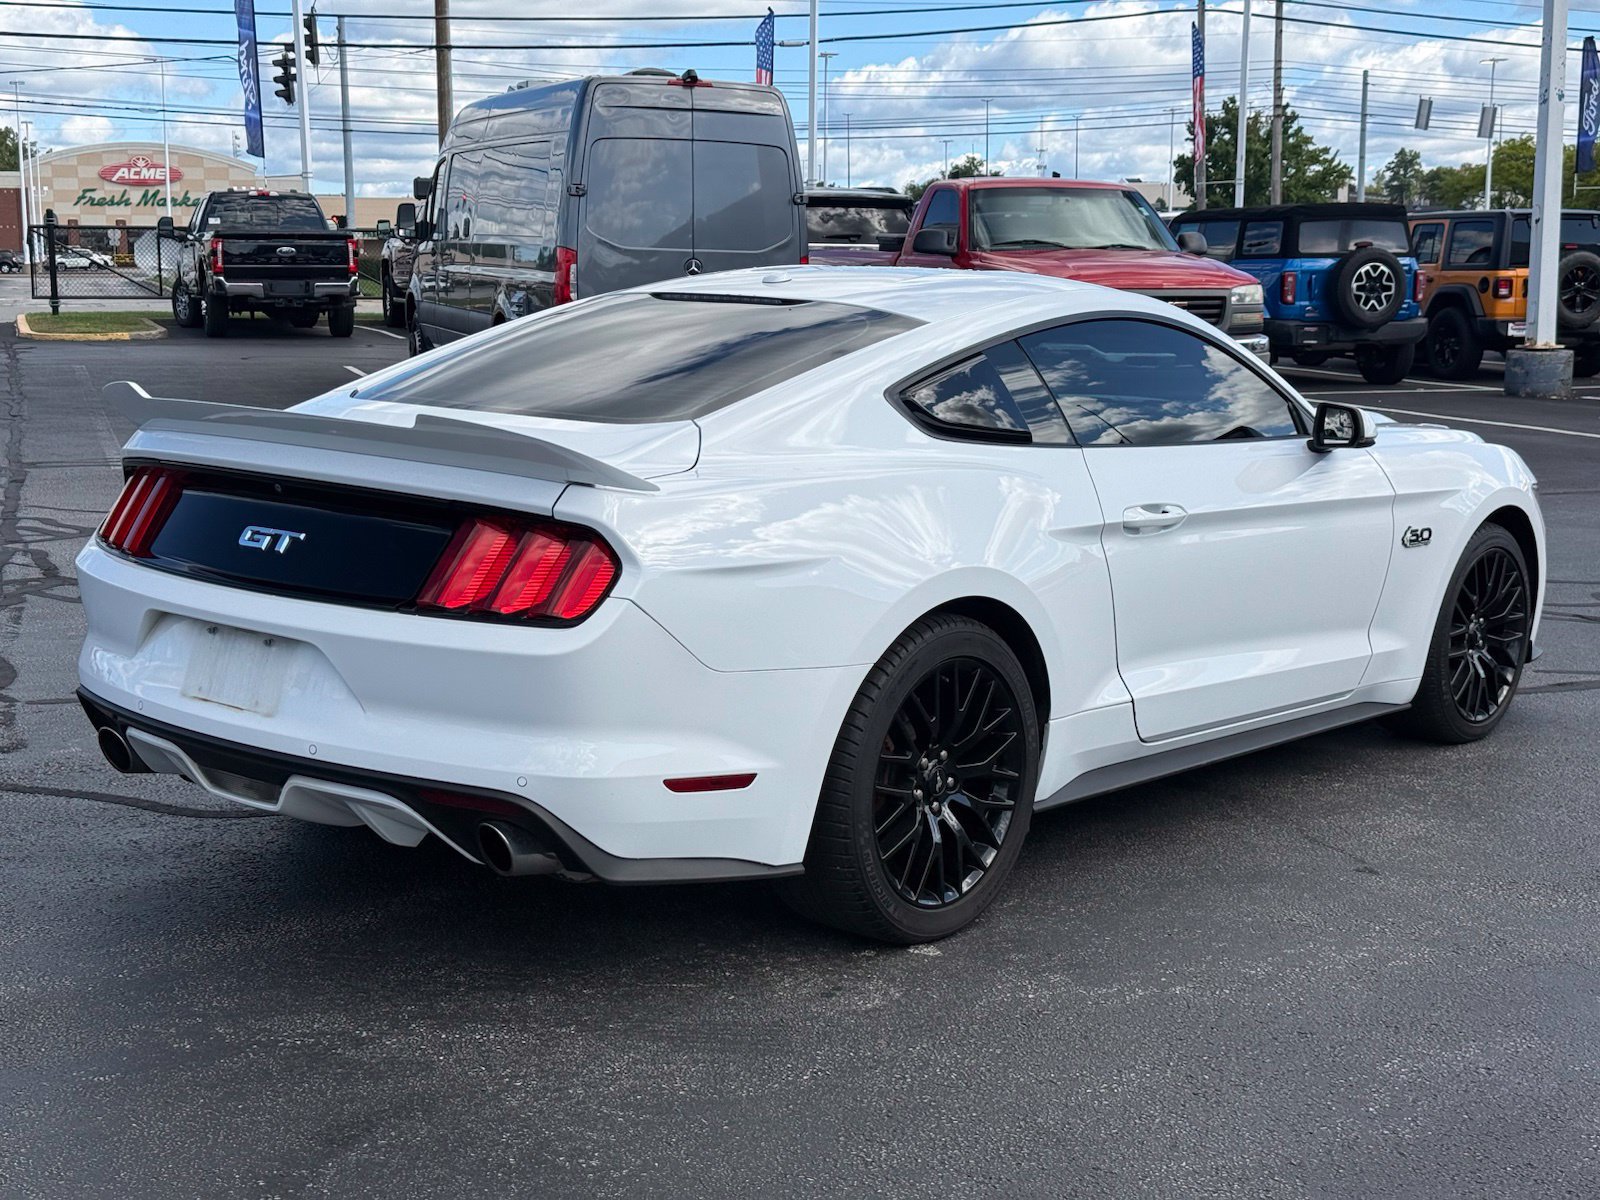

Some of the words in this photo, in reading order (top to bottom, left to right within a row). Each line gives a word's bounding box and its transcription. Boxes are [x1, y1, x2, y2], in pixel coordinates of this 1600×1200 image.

[1583, 78, 1599, 136] Ford
[111, 167, 166, 181] ACME
[73, 188, 132, 207] Fresh
[136, 189, 201, 207] Marke
[239, 525, 306, 554] GT
